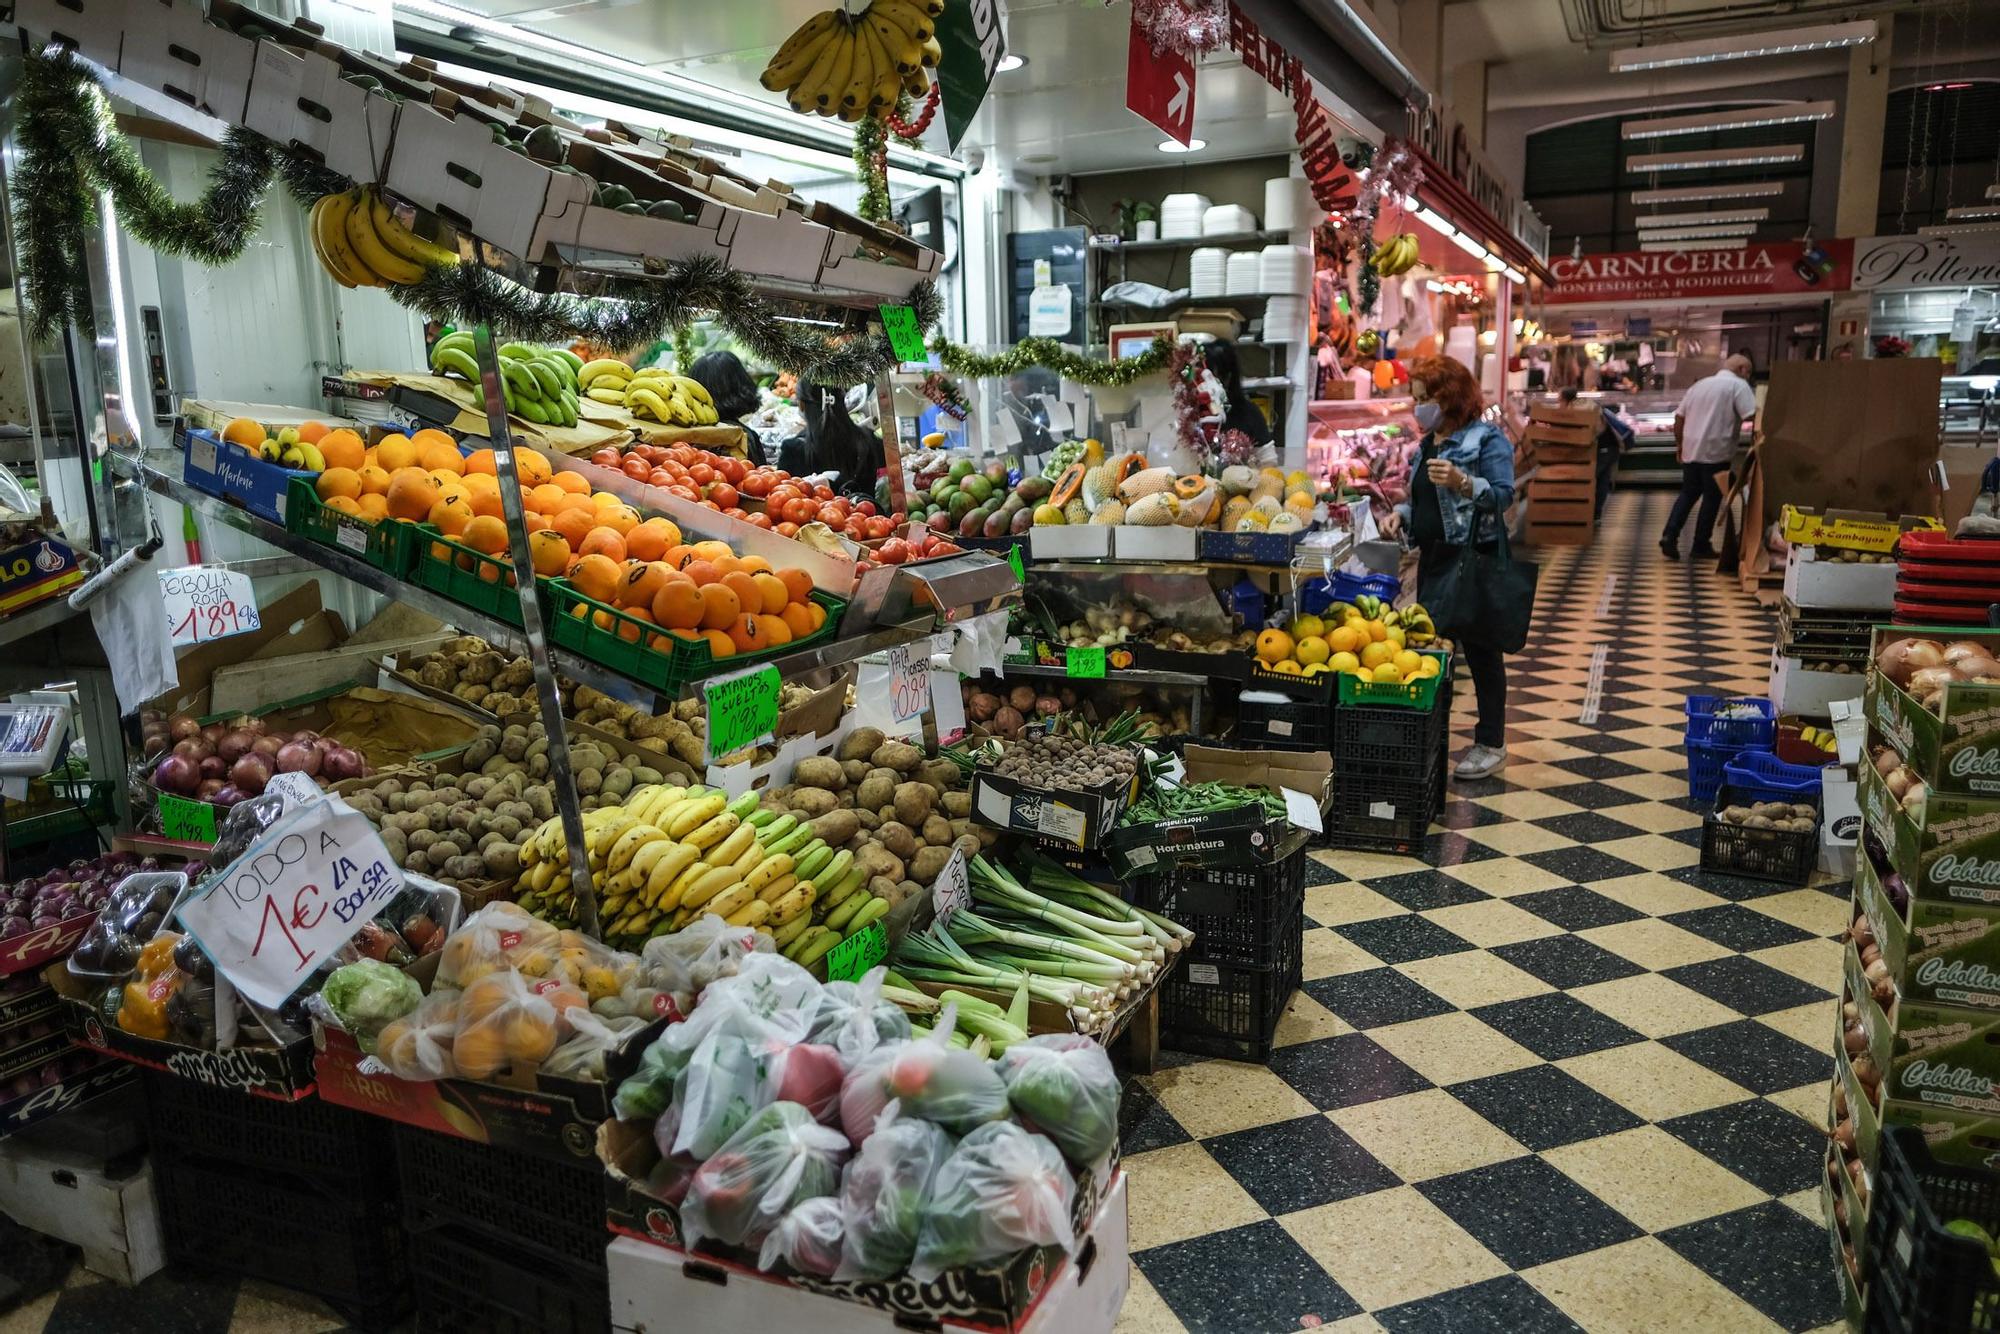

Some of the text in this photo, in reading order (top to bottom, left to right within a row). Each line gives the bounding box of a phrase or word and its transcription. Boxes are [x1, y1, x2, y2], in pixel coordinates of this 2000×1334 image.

[1551, 250, 1775, 281] CARNICERIA
[1675, 272, 1775, 289] RODRIGUEZ
[217, 463, 253, 490] Marlene
[191, 588, 229, 607] ROJA
[708, 673, 760, 707] PLATANOS
[721, 682, 770, 715] SUELTOS
[1156, 838, 1225, 854] Hortynatura
[203, 831, 341, 910] TODO A
[332, 856, 358, 890] LA
[333, 861, 389, 924] BOLSA
[1901, 1059, 1991, 1094] Cebollas
